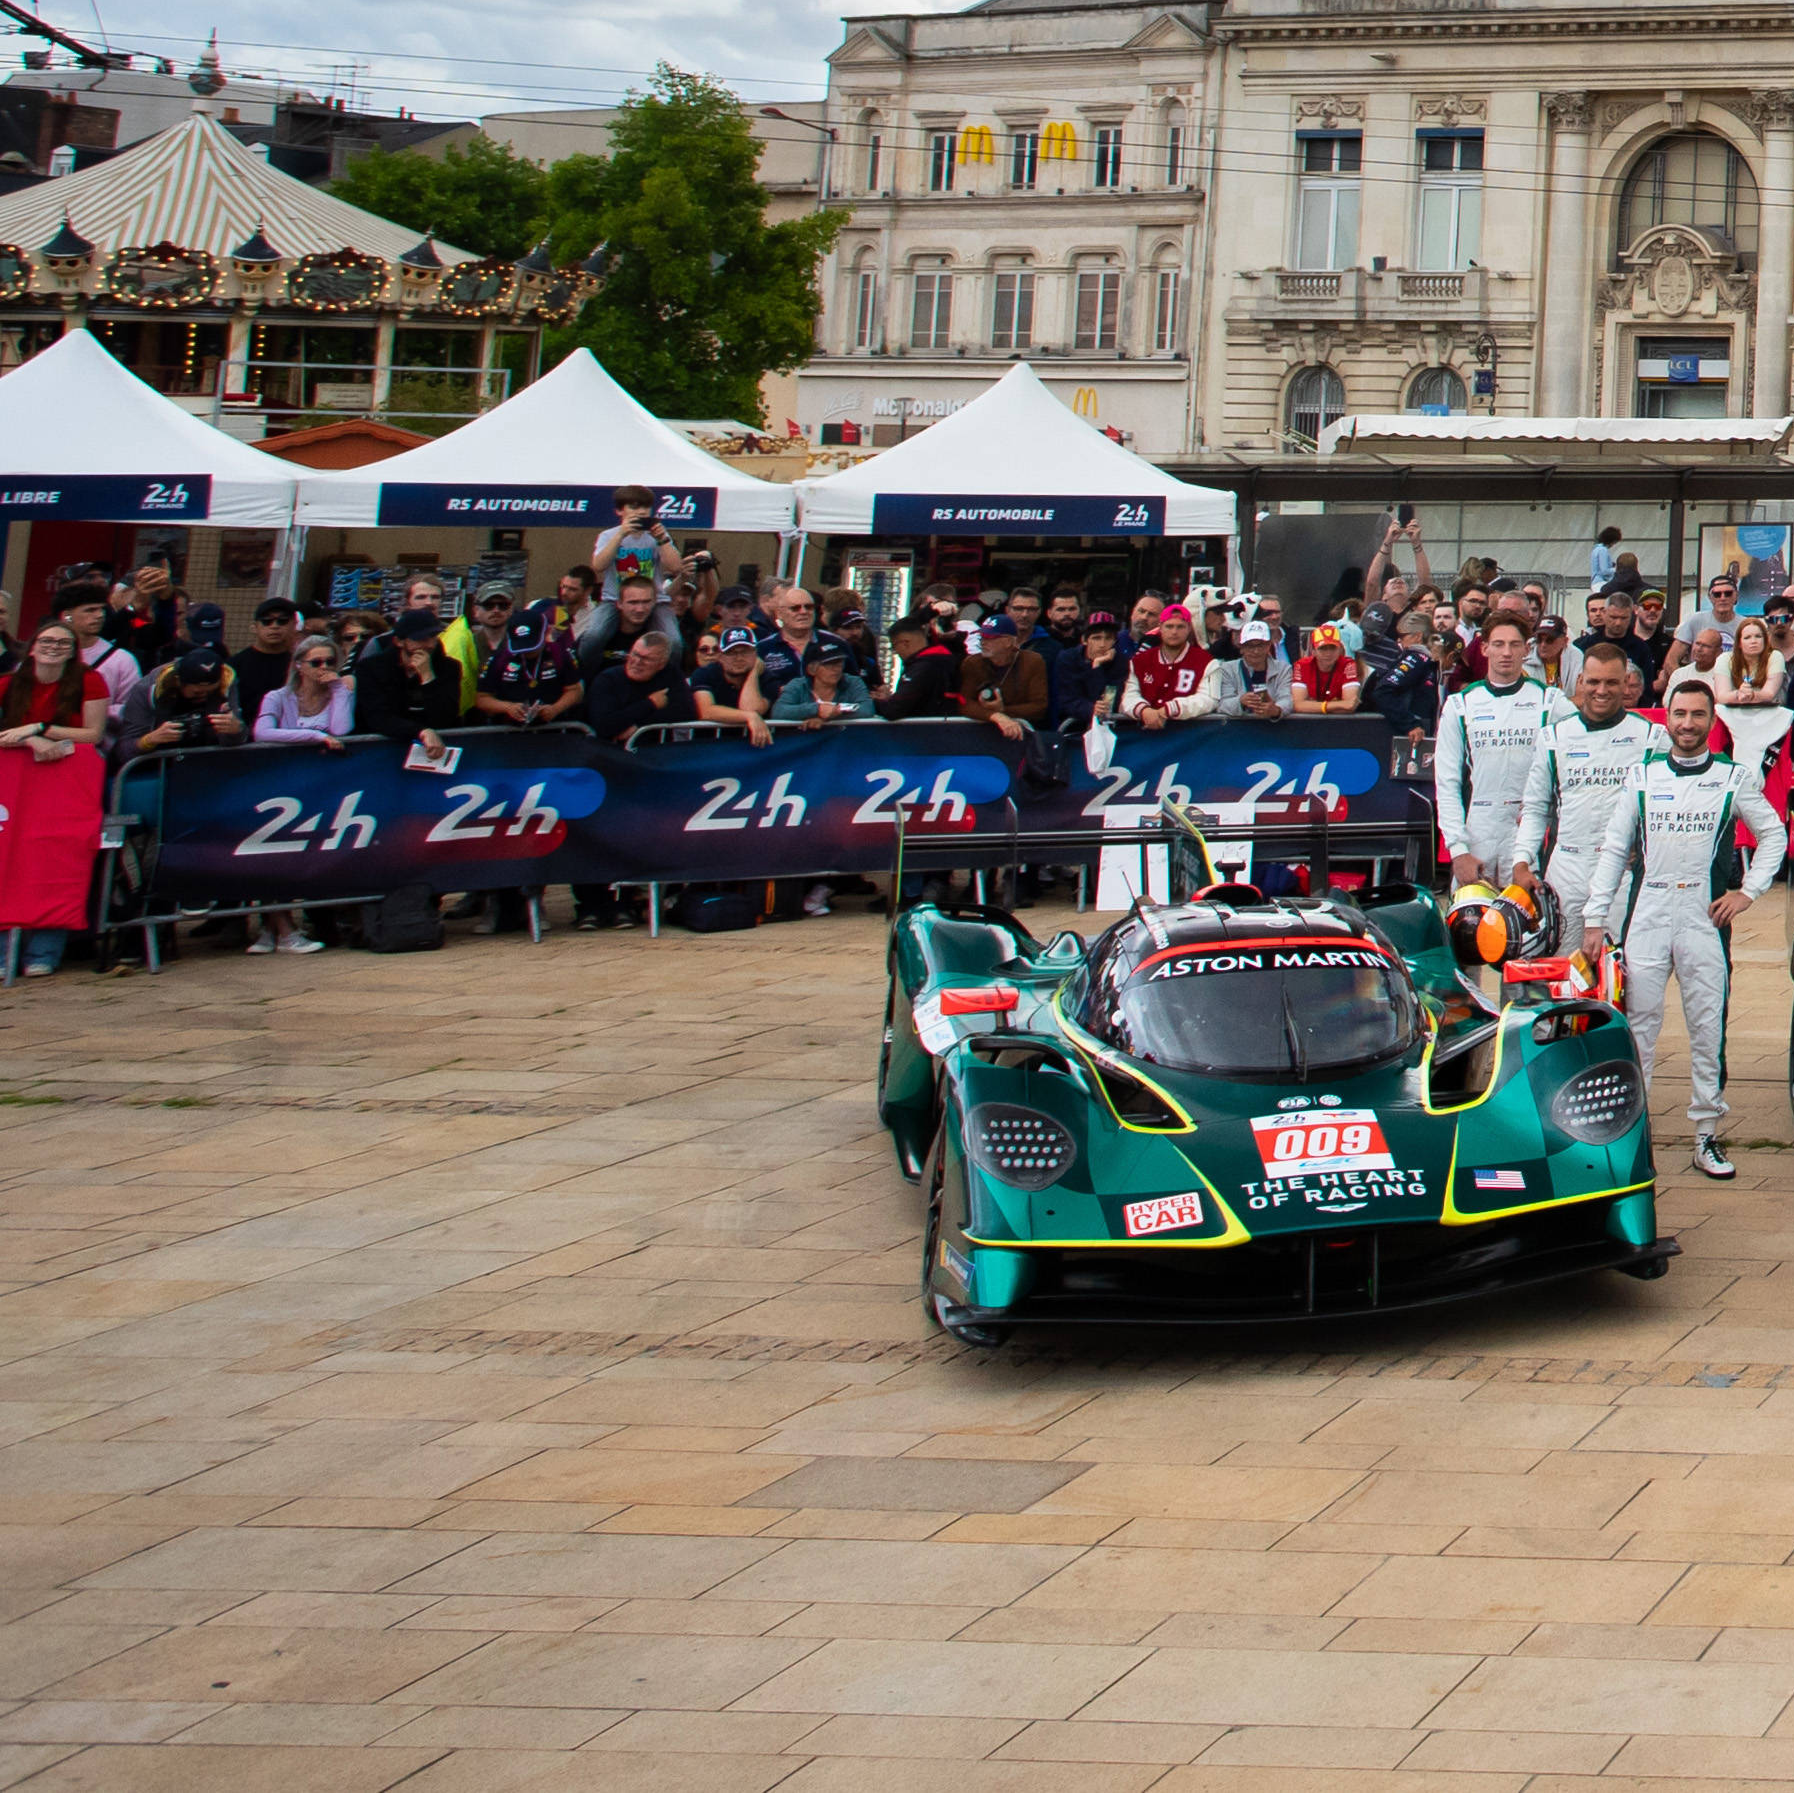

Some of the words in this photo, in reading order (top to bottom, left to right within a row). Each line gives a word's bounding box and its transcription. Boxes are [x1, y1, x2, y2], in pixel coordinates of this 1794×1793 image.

[1669, 359, 1693, 371] LCL
[1, 491, 62, 504] LIBRE
[447, 498, 472, 511] RS
[474, 499, 588, 512] AUTOMOBILE
[932, 508, 953, 520] RS
[956, 509, 1054, 521] AUTOMOBILE
[1115, 503, 1149, 521] 24h
[1474, 730, 1495, 739] THE
[1498, 728, 1535, 737] HEART
[1475, 739, 1487, 748] OF
[1492, 737, 1533, 747] RACING
[1568, 768, 1588, 776] THE
[1592, 767, 1630, 775] HEART
[1241, 761, 1342, 813] 24h
[1568, 777, 1581, 786] OF
[684, 772, 807, 831] 24h
[851, 768, 967, 824] 24h
[425, 782, 559, 843] 24h
[1650, 812, 1671, 821] THE
[1676, 812, 1717, 821] HEART
[233, 790, 377, 855] 24h
[1650, 823, 1663, 832] OF
[1668, 822, 1715, 832] RACING
[1149, 955, 1263, 982] ASTON
[1273, 951, 1392, 969] MARTIN
[1273, 1125, 1372, 1161] 009
[1241, 1176, 1306, 1195] THE
[1319, 1169, 1425, 1187] HEART
[1130, 1195, 1195, 1216] HYPER
[1248, 1192, 1289, 1210] OF
[1304, 1183, 1427, 1203] RACING
[1132, 1205, 1198, 1232] CAR
